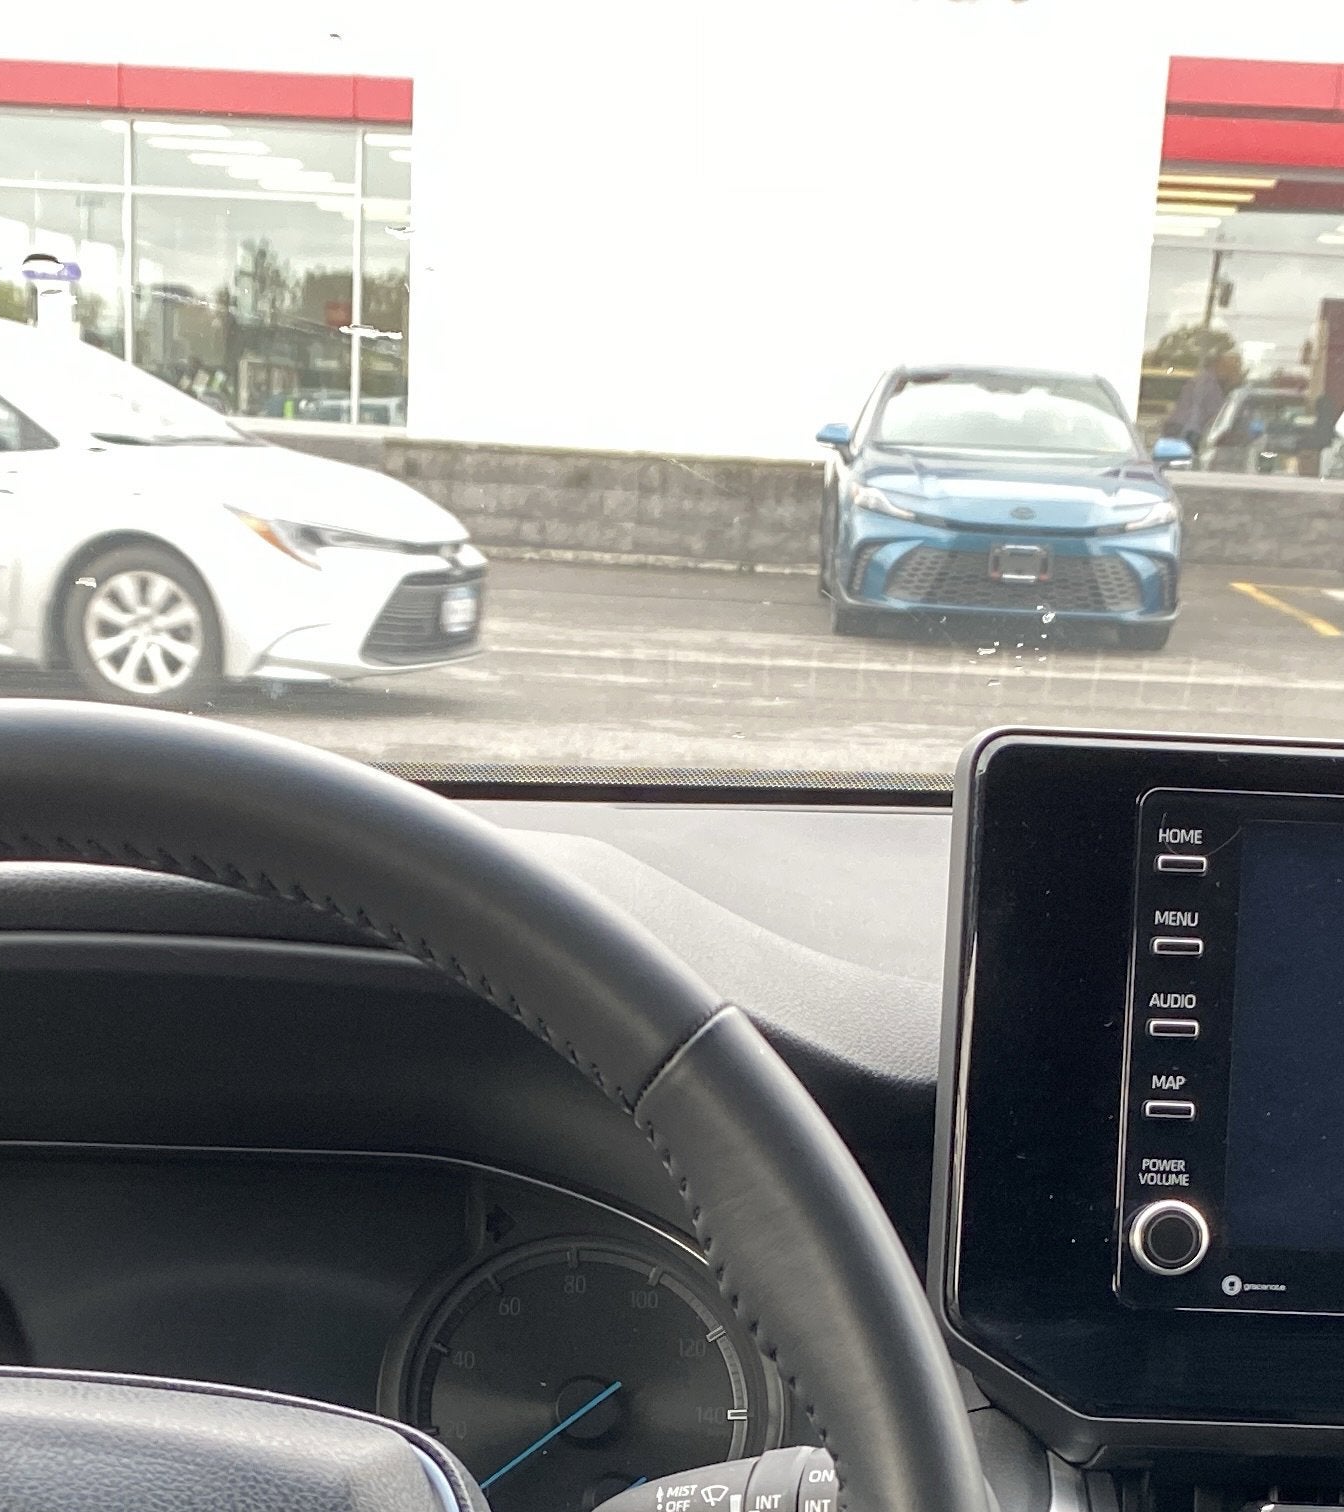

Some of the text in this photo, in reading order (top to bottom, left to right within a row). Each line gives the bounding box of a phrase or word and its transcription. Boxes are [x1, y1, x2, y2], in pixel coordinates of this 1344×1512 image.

[1158, 827, 1203, 845] HOME
[1154, 910, 1199, 928] MENU
[1149, 993, 1197, 1010] AUDIO
[1151, 1074, 1186, 1091] MAP
[1141, 1158, 1187, 1173] POWER
[1137, 1173, 1190, 1187] VOLUME
[563, 1275, 587, 1296] 80
[498, 1296, 521, 1316] 60
[629, 1290, 659, 1310] 100
[678, 1337, 707, 1358] 120
[452, 1350, 475, 1370] 40
[808, 1470, 835, 1483] ON
[665, 1484, 697, 1499] MIST
[664, 1500, 691, 1512] OFF
[755, 1494, 781, 1510] INT
